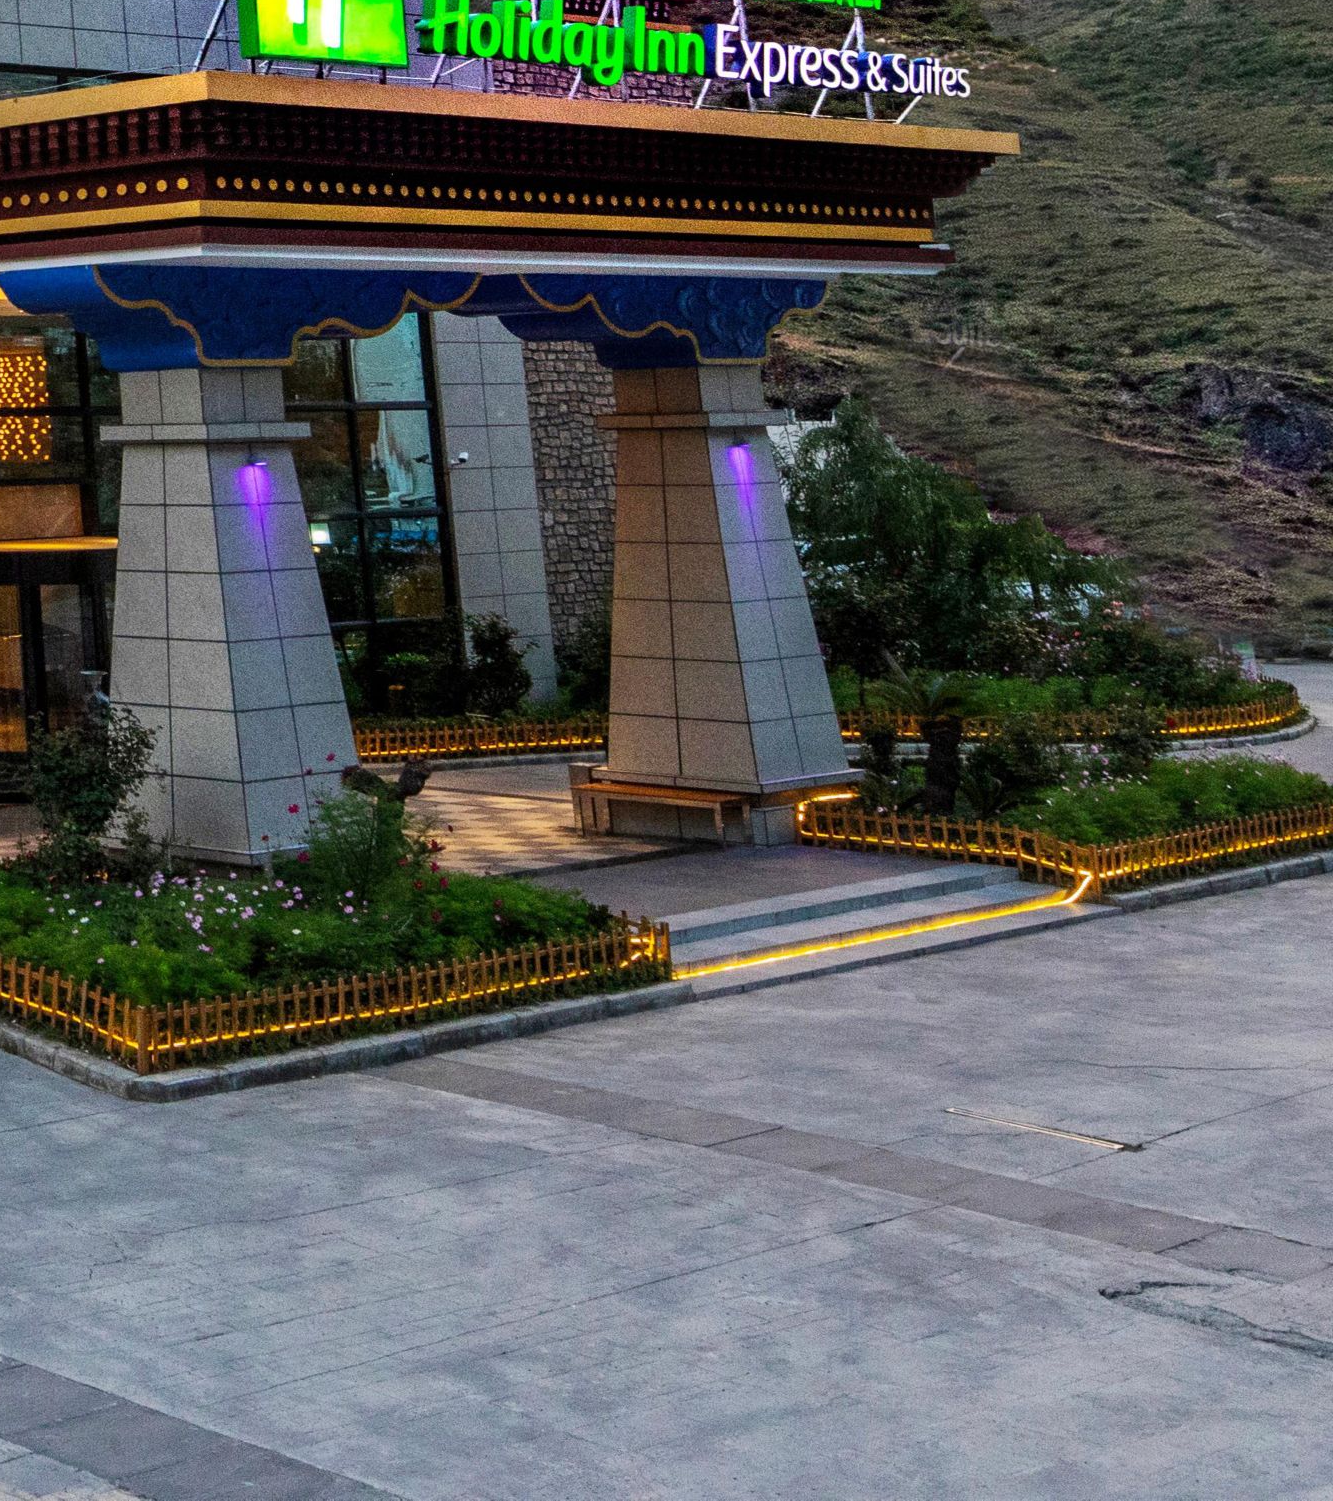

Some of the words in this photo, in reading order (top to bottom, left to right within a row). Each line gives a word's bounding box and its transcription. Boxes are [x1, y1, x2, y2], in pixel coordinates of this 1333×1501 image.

[628, 5, 706, 77] Inn
[714, 22, 860, 98] Express
[865, 52, 889, 93] &
[892, 53, 972, 99] Suites
